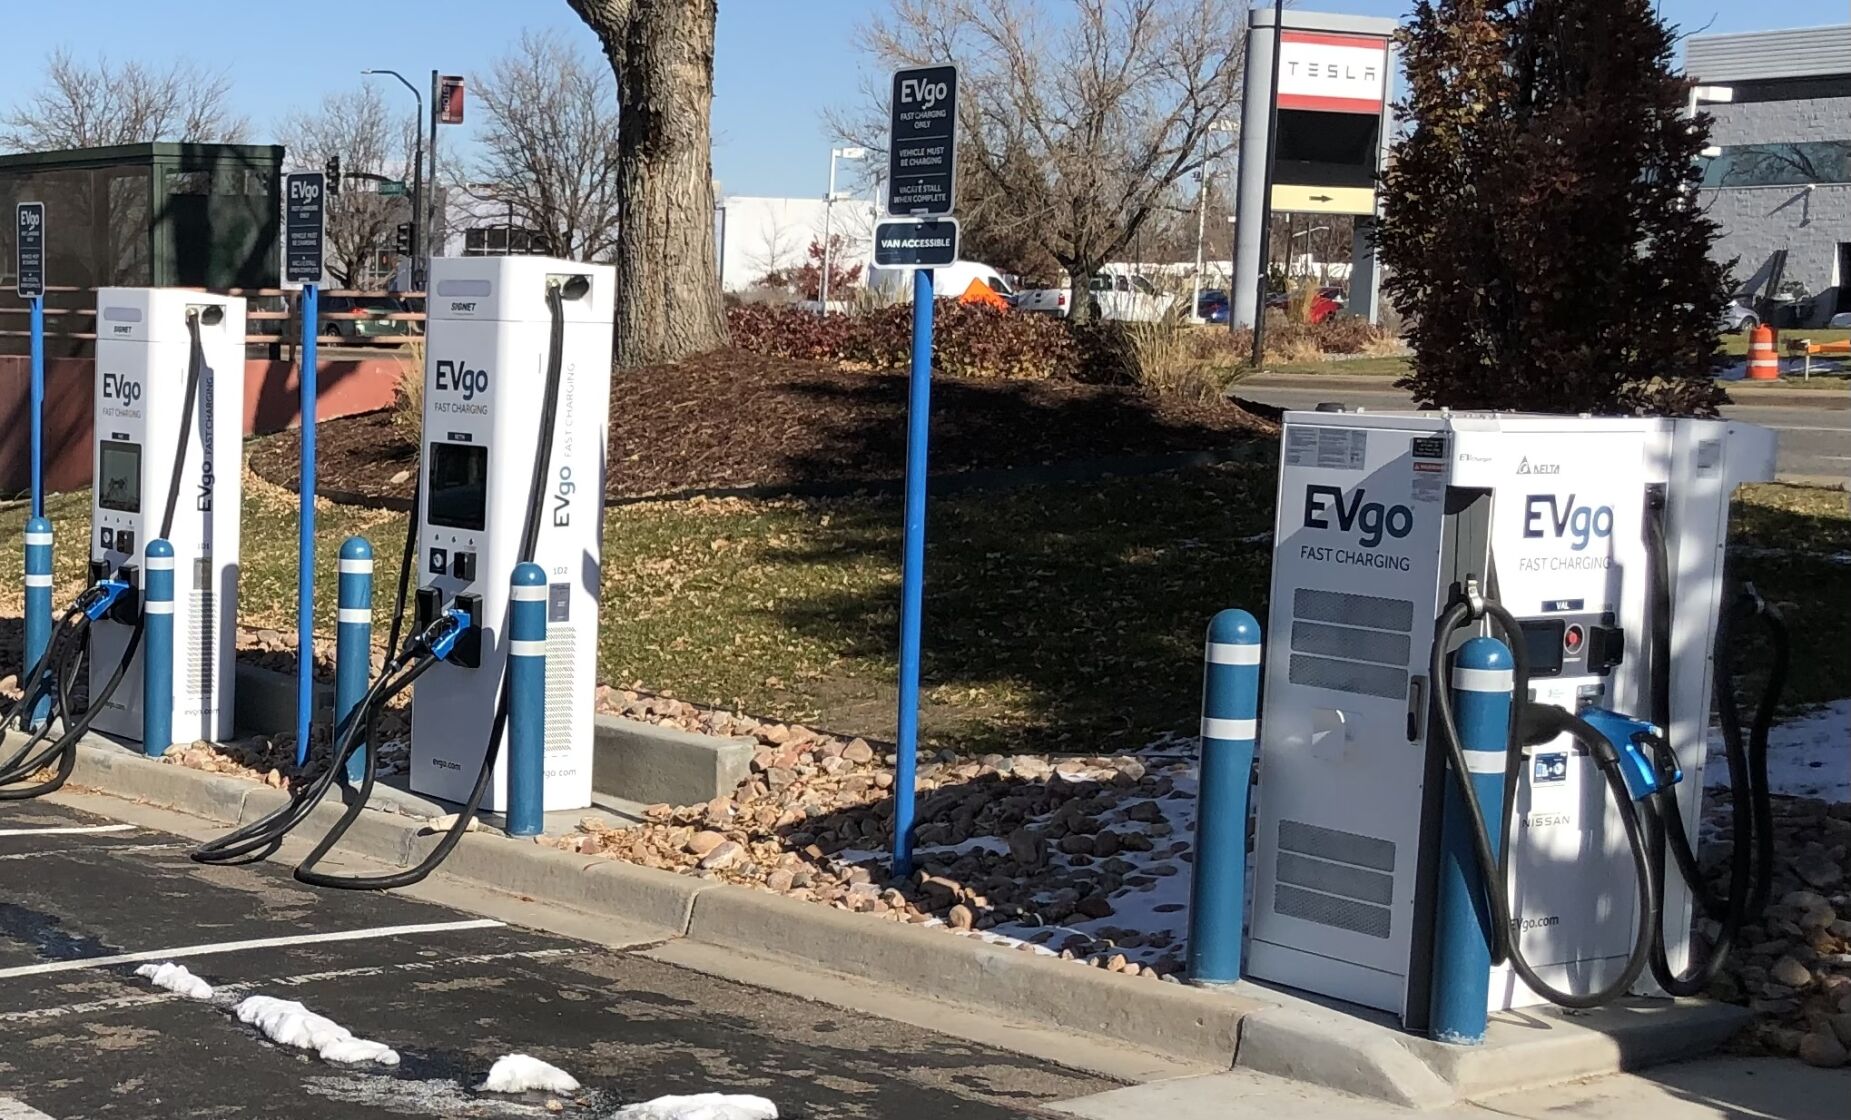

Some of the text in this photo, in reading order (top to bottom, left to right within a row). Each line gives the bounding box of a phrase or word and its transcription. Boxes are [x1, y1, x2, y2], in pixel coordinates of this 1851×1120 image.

[1288, 61, 1375, 81] TESLA
[901, 78, 947, 110] EVgo
[900, 109, 946, 120] FAST CHARGING
[914, 121, 931, 129] ONLY
[899, 147, 944, 157] VEHICLE MUST
[900, 157, 942, 167] BE CHARGING
[291, 181, 319, 205] EVgo
[912, 193, 946, 203] COMPLETE
[21, 210, 40, 231] EVgo
[881, 238, 951, 248] VAN ACCESSIBLE
[451, 302, 477, 312] SIGNET
[435, 360, 489, 400] EVgo
[103, 373, 142, 407] EVgo
[102, 407, 142, 418] FAST CHARGING
[434, 402, 488, 415] FAST CHARGING
[197, 461, 215, 512] EVgo
[553, 466, 576, 528] EVgo
[1304, 484, 1414, 548] EVgo
[1523, 493, 1614, 551] EVgo
[1300, 545, 1411, 572] FAST CHARGING
[1519, 556, 1611, 571] FAST CHARGING
[1556, 601, 1570, 610] VAL
[432, 757, 461, 771] evgo.com
[1522, 816, 1571, 828] NISSAN
